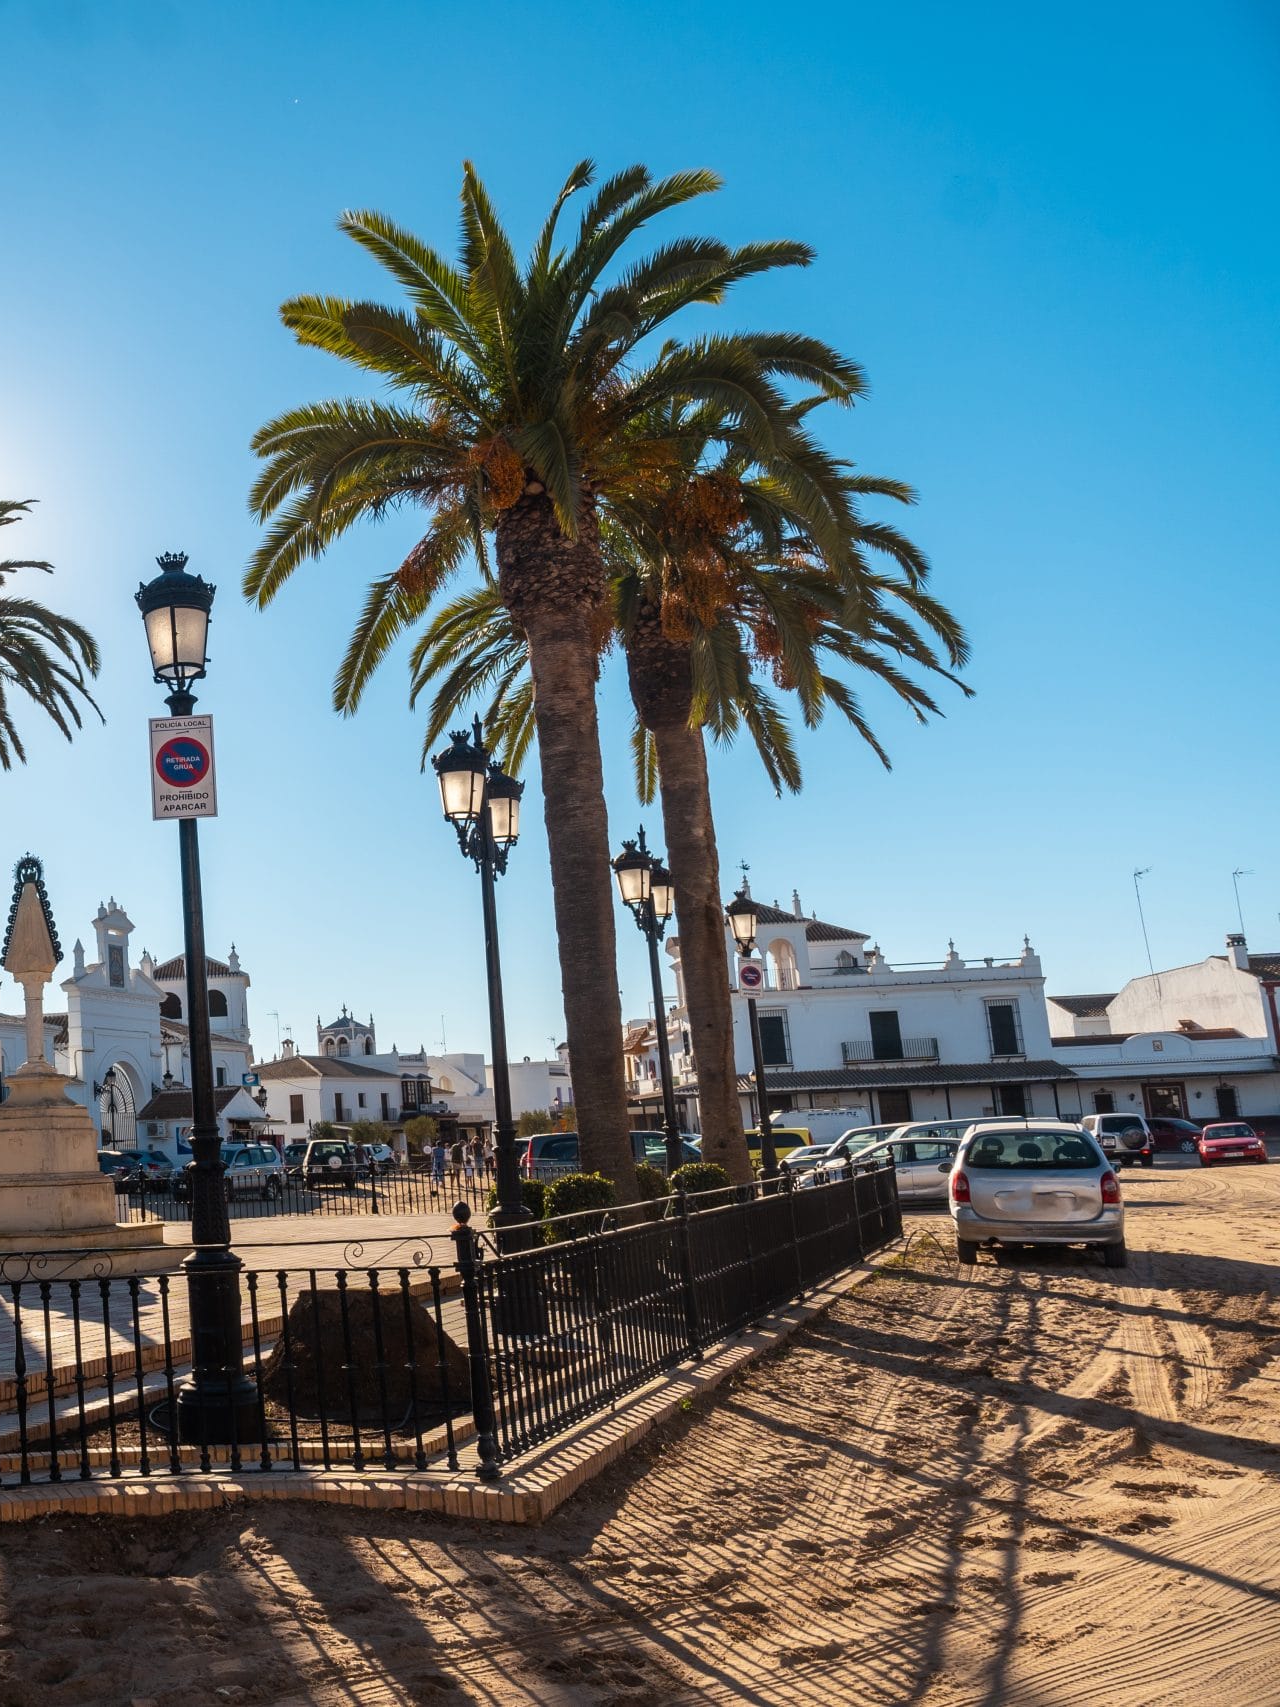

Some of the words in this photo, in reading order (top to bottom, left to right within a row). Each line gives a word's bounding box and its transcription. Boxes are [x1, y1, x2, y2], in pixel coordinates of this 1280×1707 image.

[166, 756, 200, 764] RETIRADA
[159, 792, 209, 802] PROHIBIDO
[163, 802, 207, 812] APARCAR
